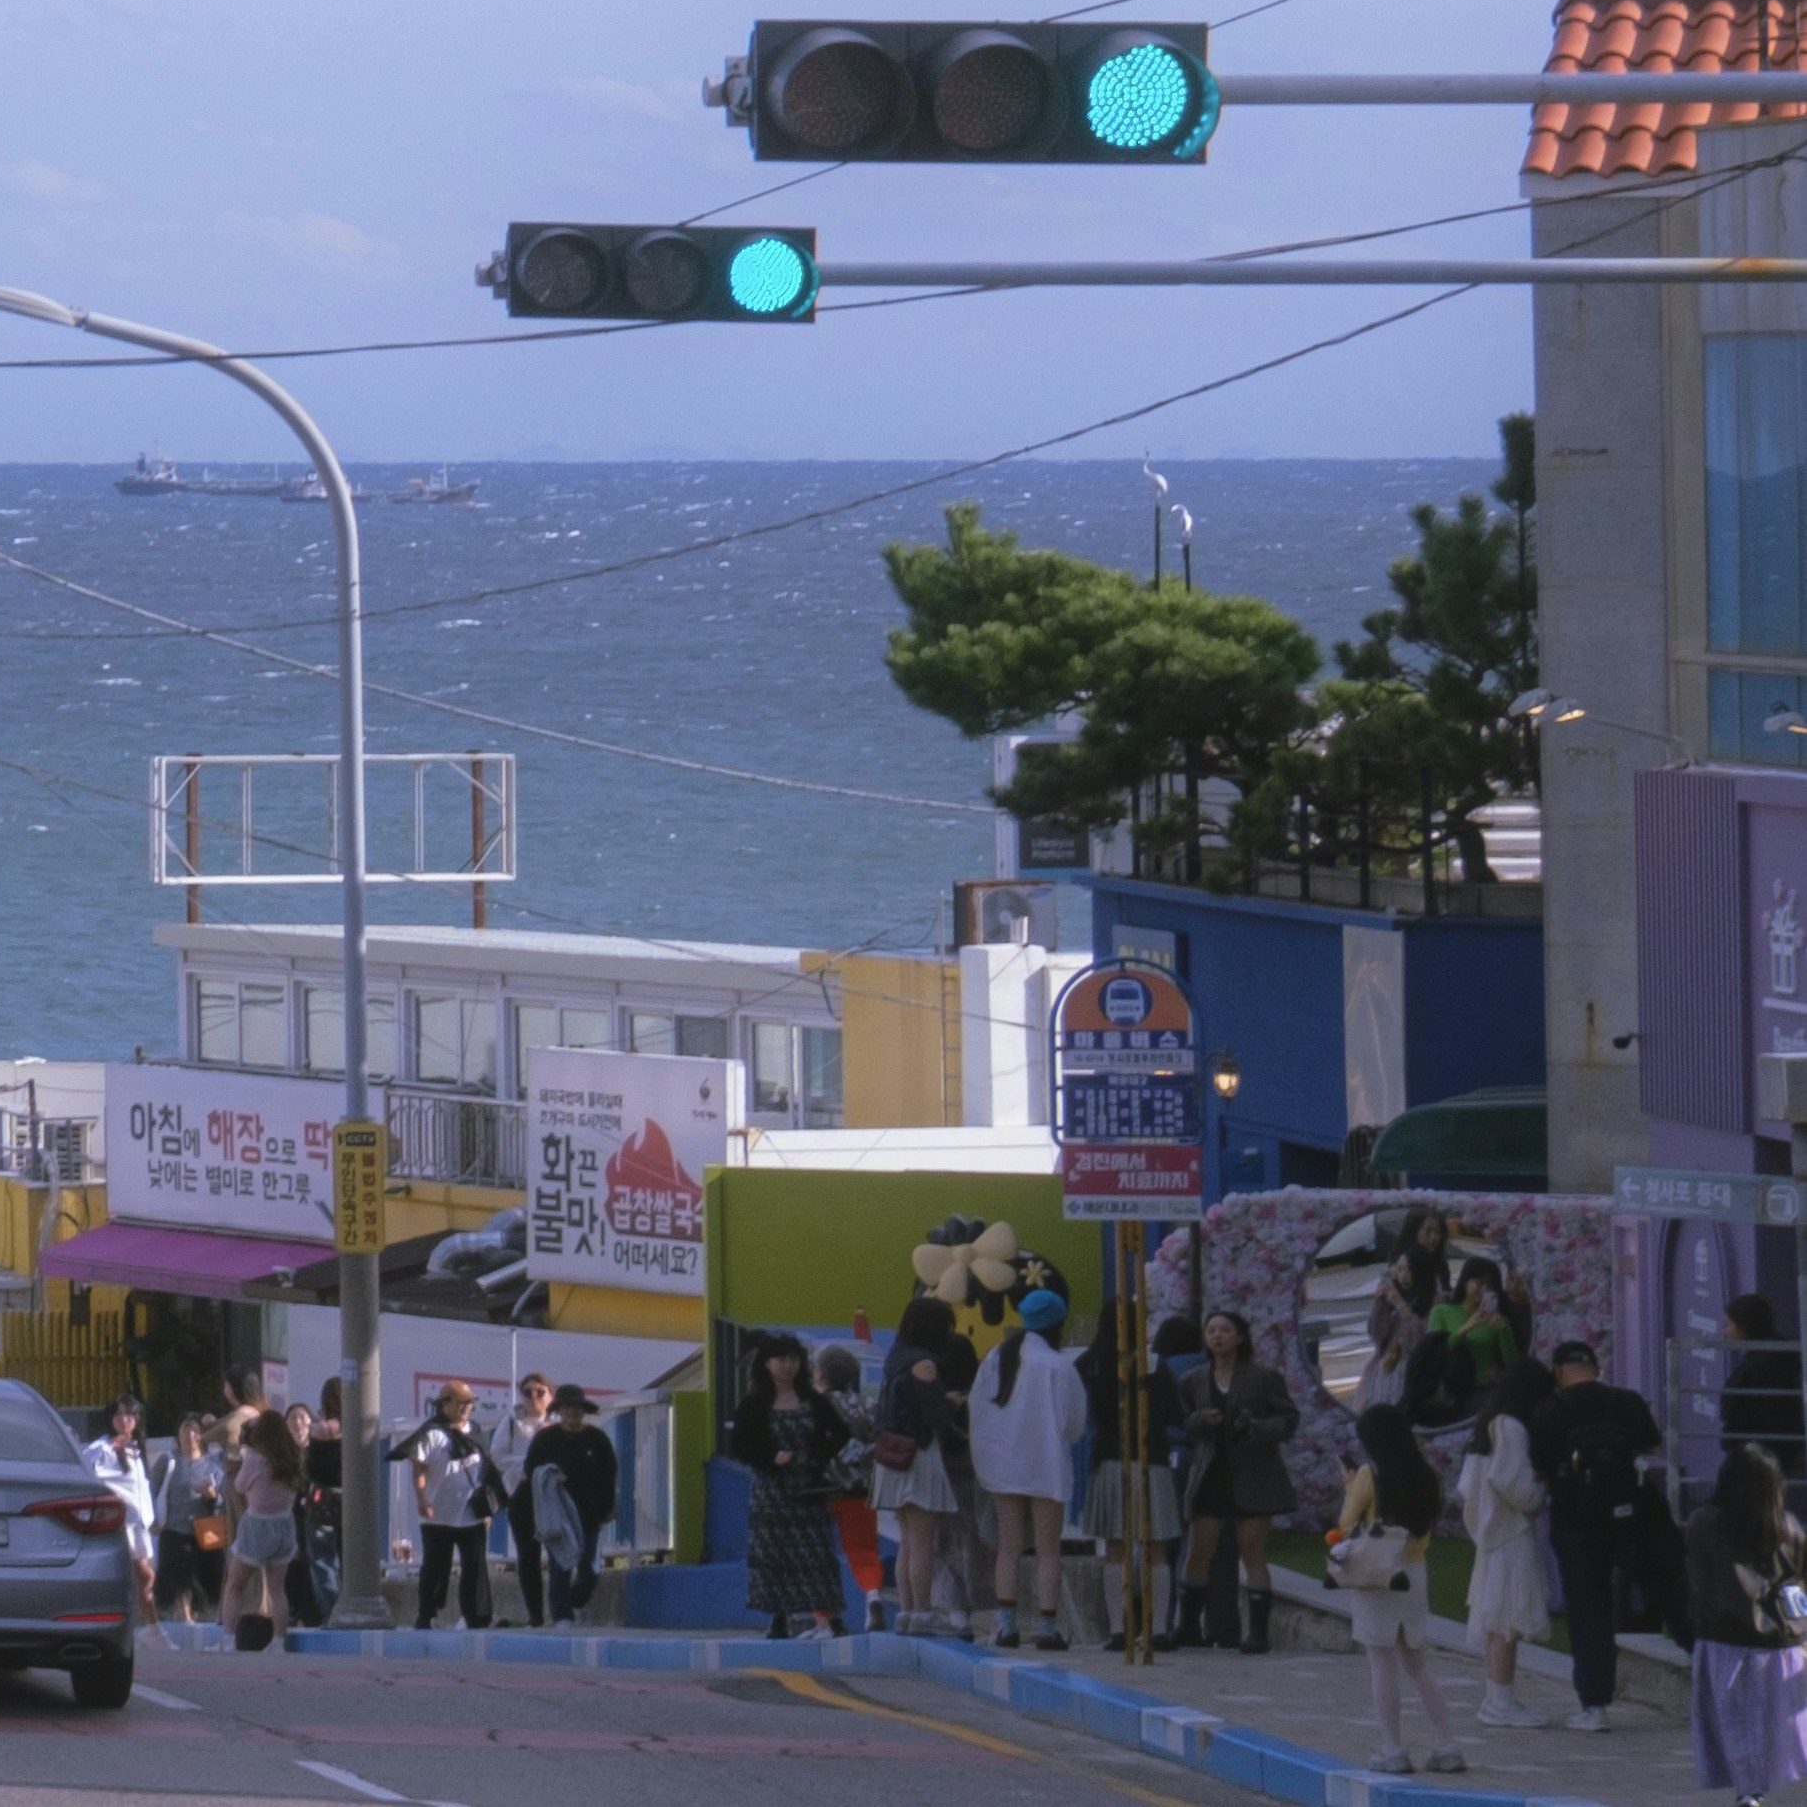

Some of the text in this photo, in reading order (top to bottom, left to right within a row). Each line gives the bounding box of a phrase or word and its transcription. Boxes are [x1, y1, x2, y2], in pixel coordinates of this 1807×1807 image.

[129, 1101, 201, 1158] 아침에
[207, 1108, 298, 1166] 해장으로
[540, 1131, 599, 1193] 화끈
[147, 1158, 197, 1193] 낮에는
[205, 1164, 255, 1197] 별미로
[1645, 1177, 1691, 1204] 청사포
[532, 1186, 606, 1257] 불맛!
